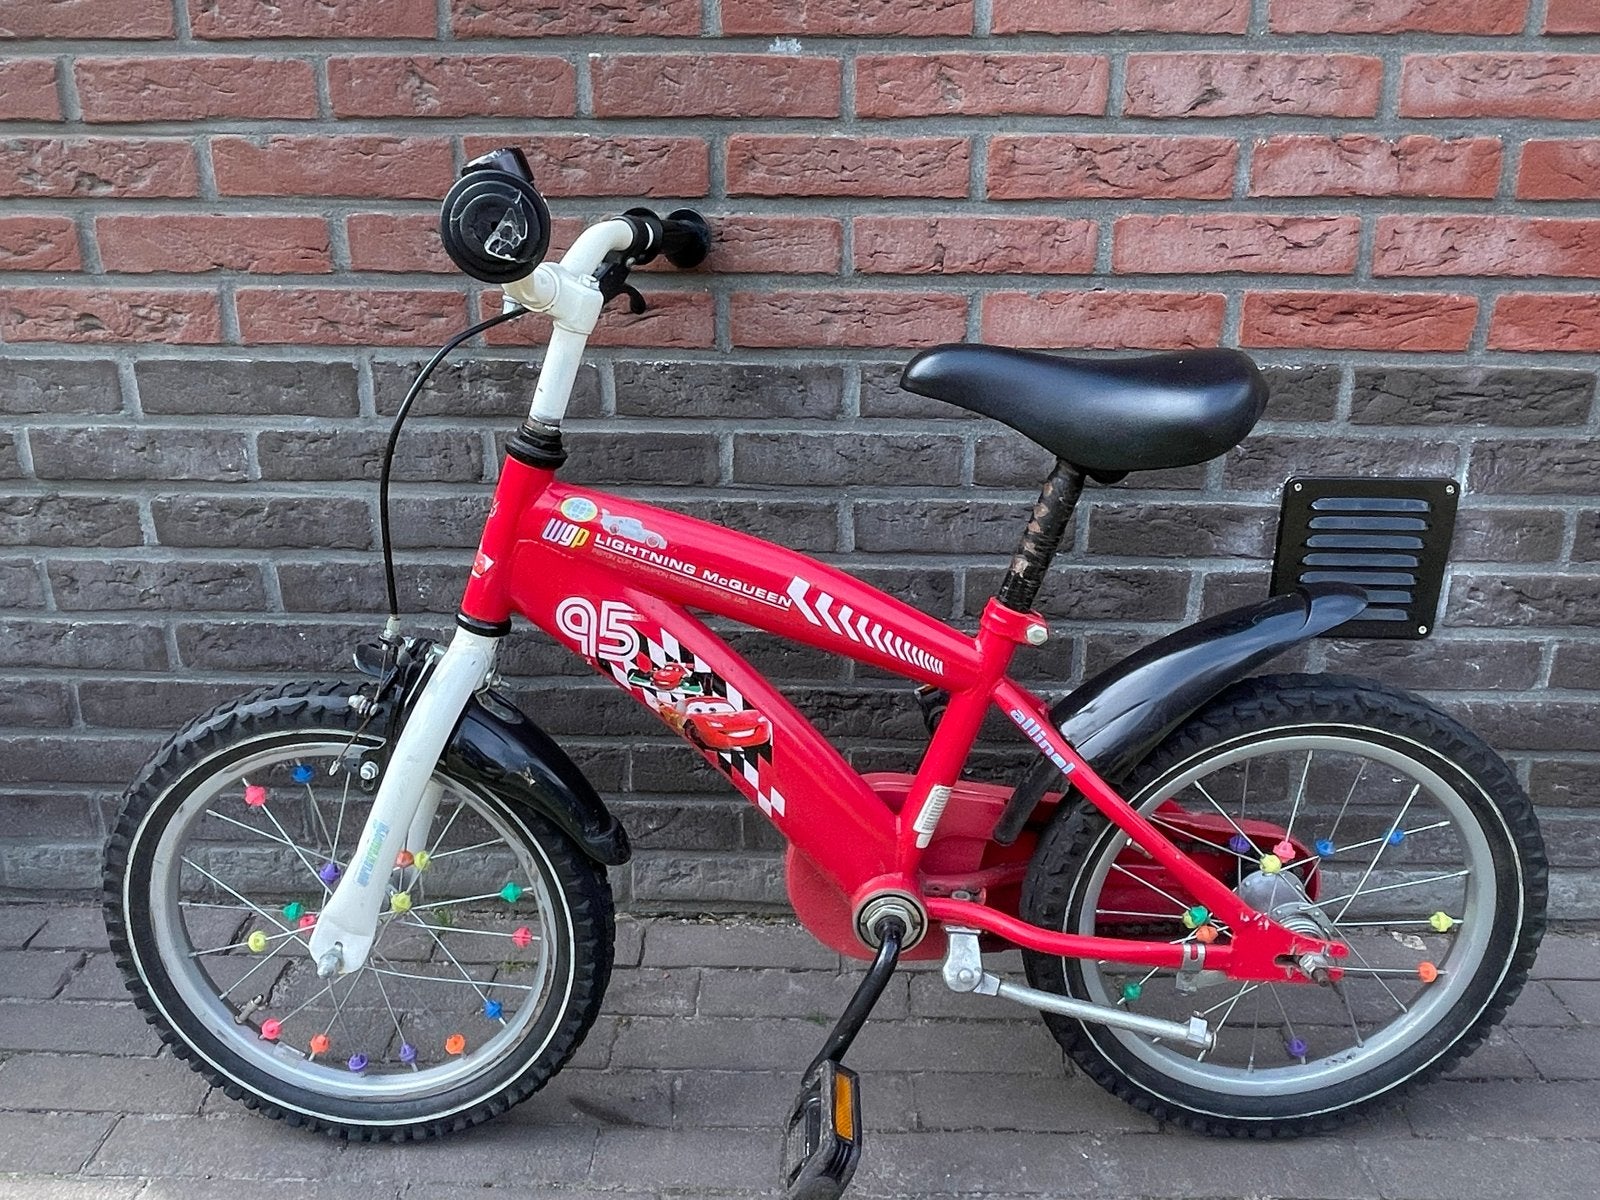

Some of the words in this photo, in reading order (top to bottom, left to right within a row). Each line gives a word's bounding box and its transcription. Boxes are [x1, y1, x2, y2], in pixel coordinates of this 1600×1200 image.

[594, 533, 696, 575] LIGHTNING
[702, 569, 792, 608] McQUEEN
[556, 596, 641, 663] 95
